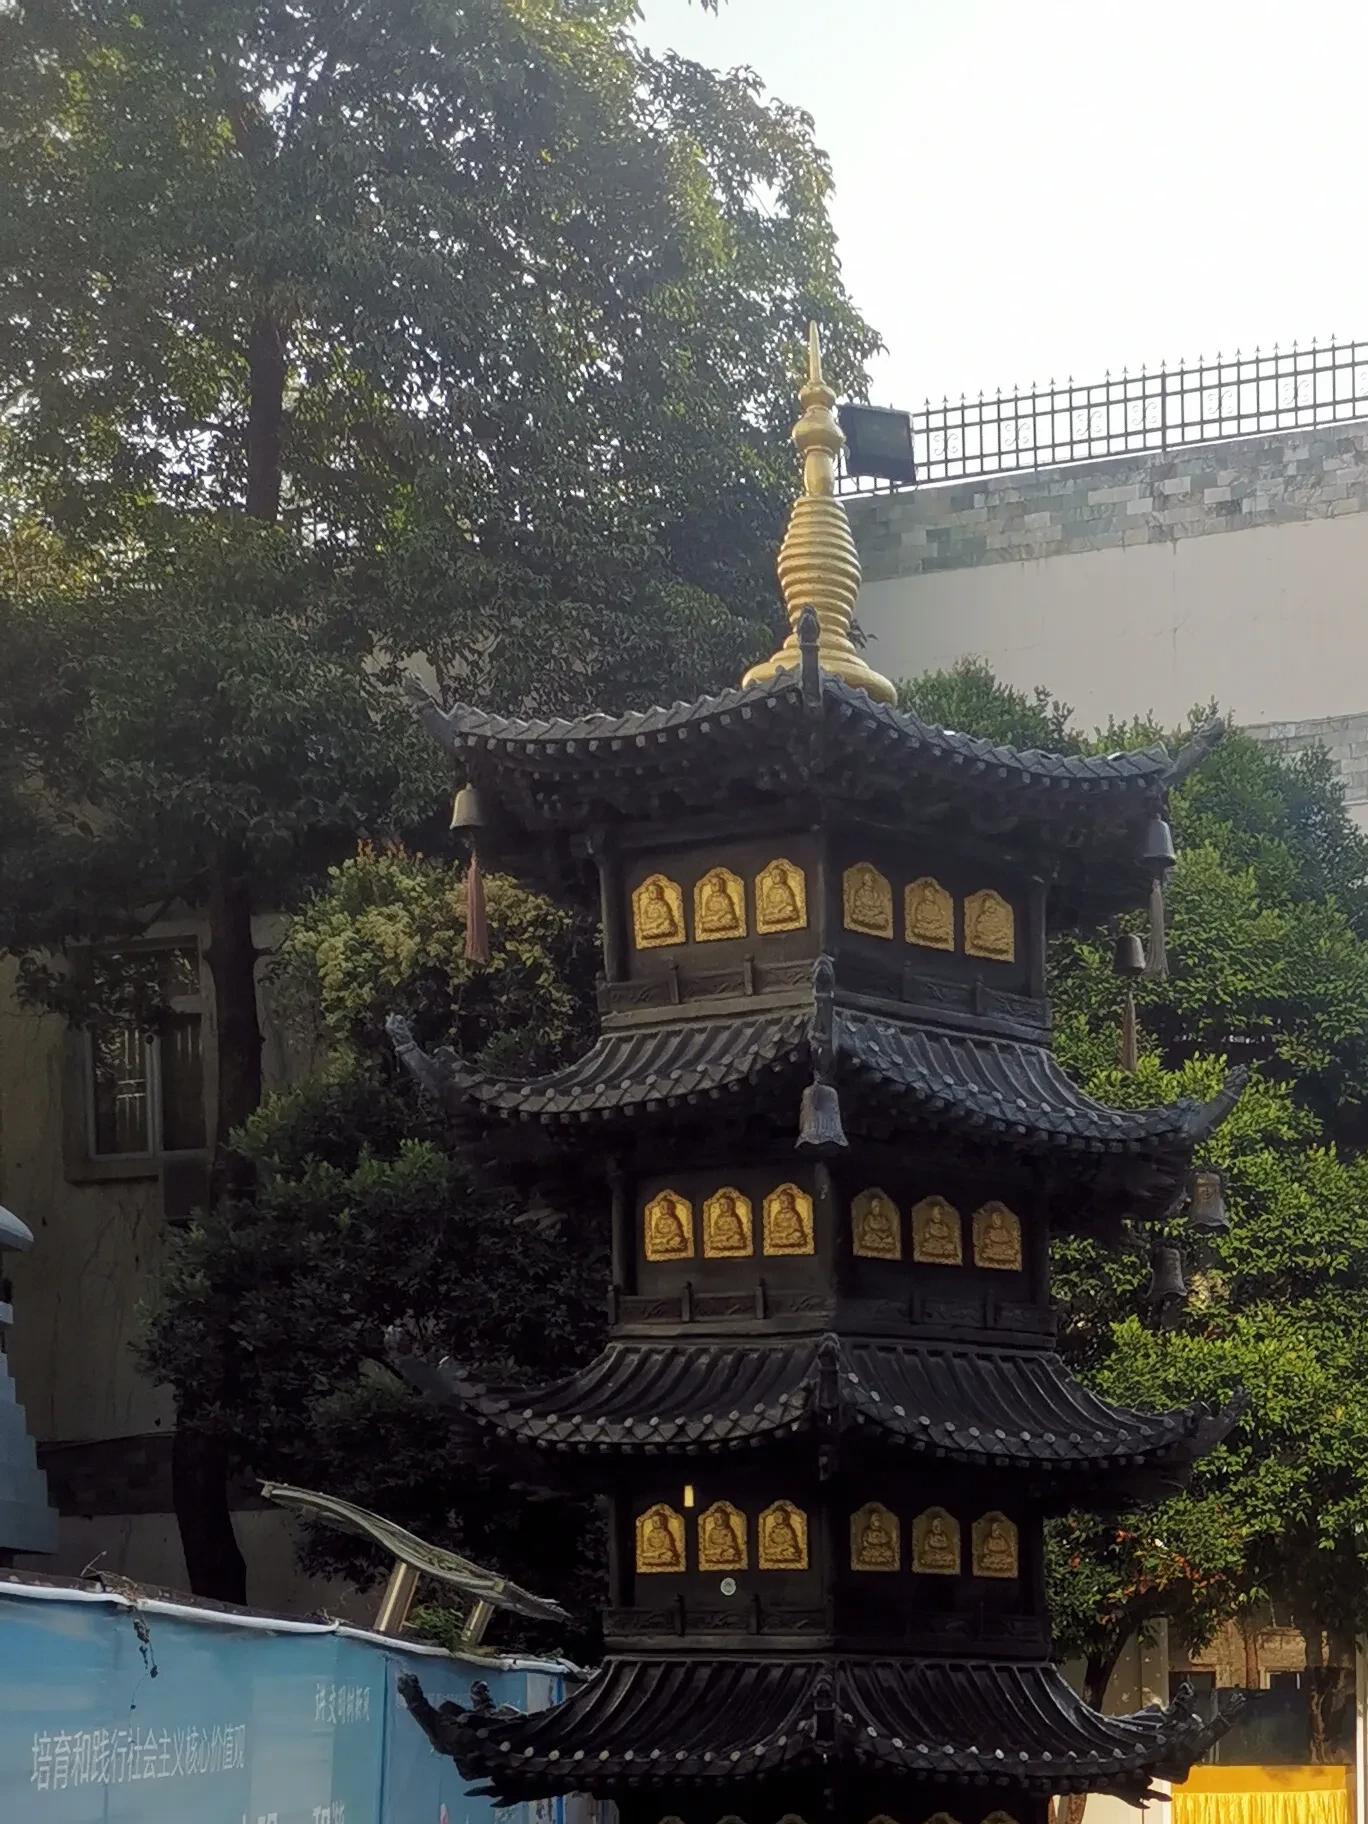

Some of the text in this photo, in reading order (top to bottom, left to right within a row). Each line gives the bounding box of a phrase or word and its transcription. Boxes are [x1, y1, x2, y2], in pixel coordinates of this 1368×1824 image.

[30, 1723, 246, 1791] 培育和践行社会主义核心价值观
